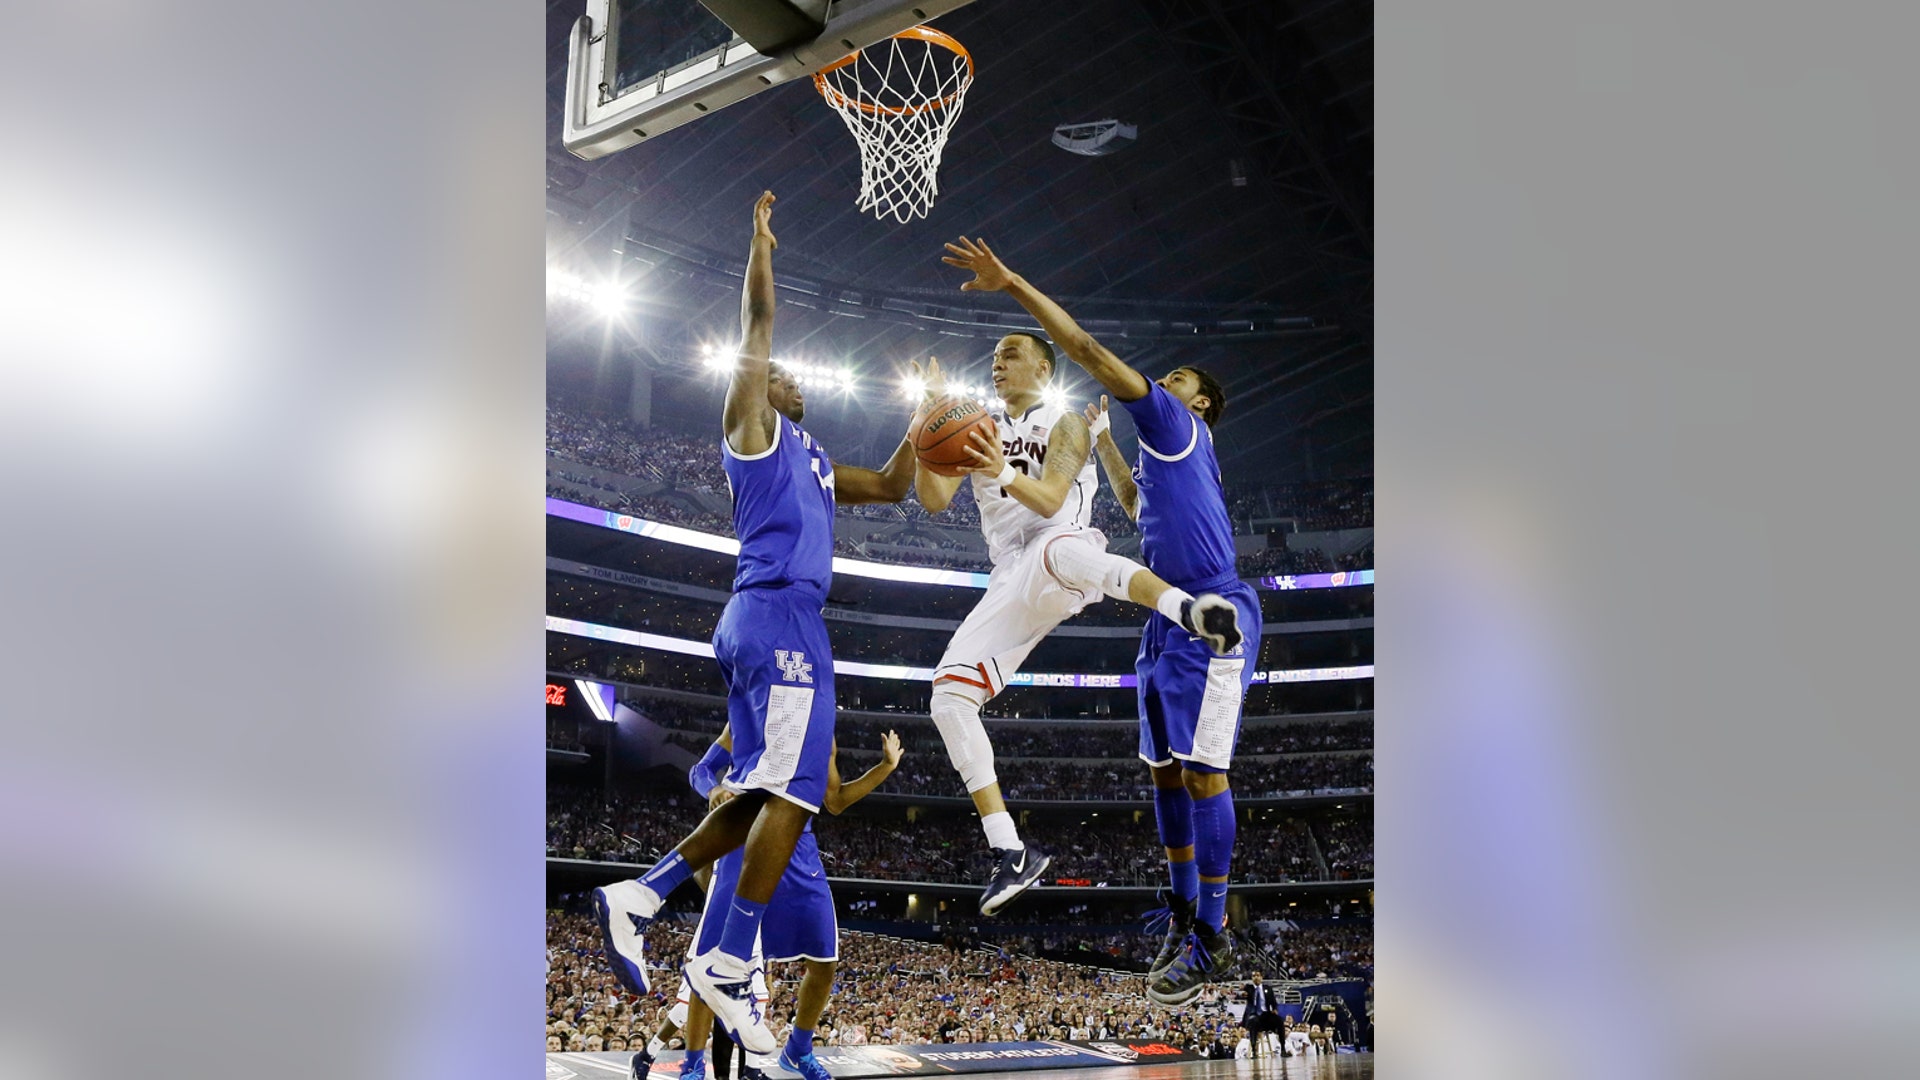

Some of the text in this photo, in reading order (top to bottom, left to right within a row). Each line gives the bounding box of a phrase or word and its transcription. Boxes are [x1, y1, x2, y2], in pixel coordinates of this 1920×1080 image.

[928, 402, 980, 433] Wilson
[592, 567, 612, 580] TOM
[614, 573, 649, 587] LANDRY
[822, 608, 844, 619] SETT
[775, 649, 813, 684] UK
[1009, 673, 1121, 687] OAD ENDS HERE
[1251, 671, 1267, 681] AD
